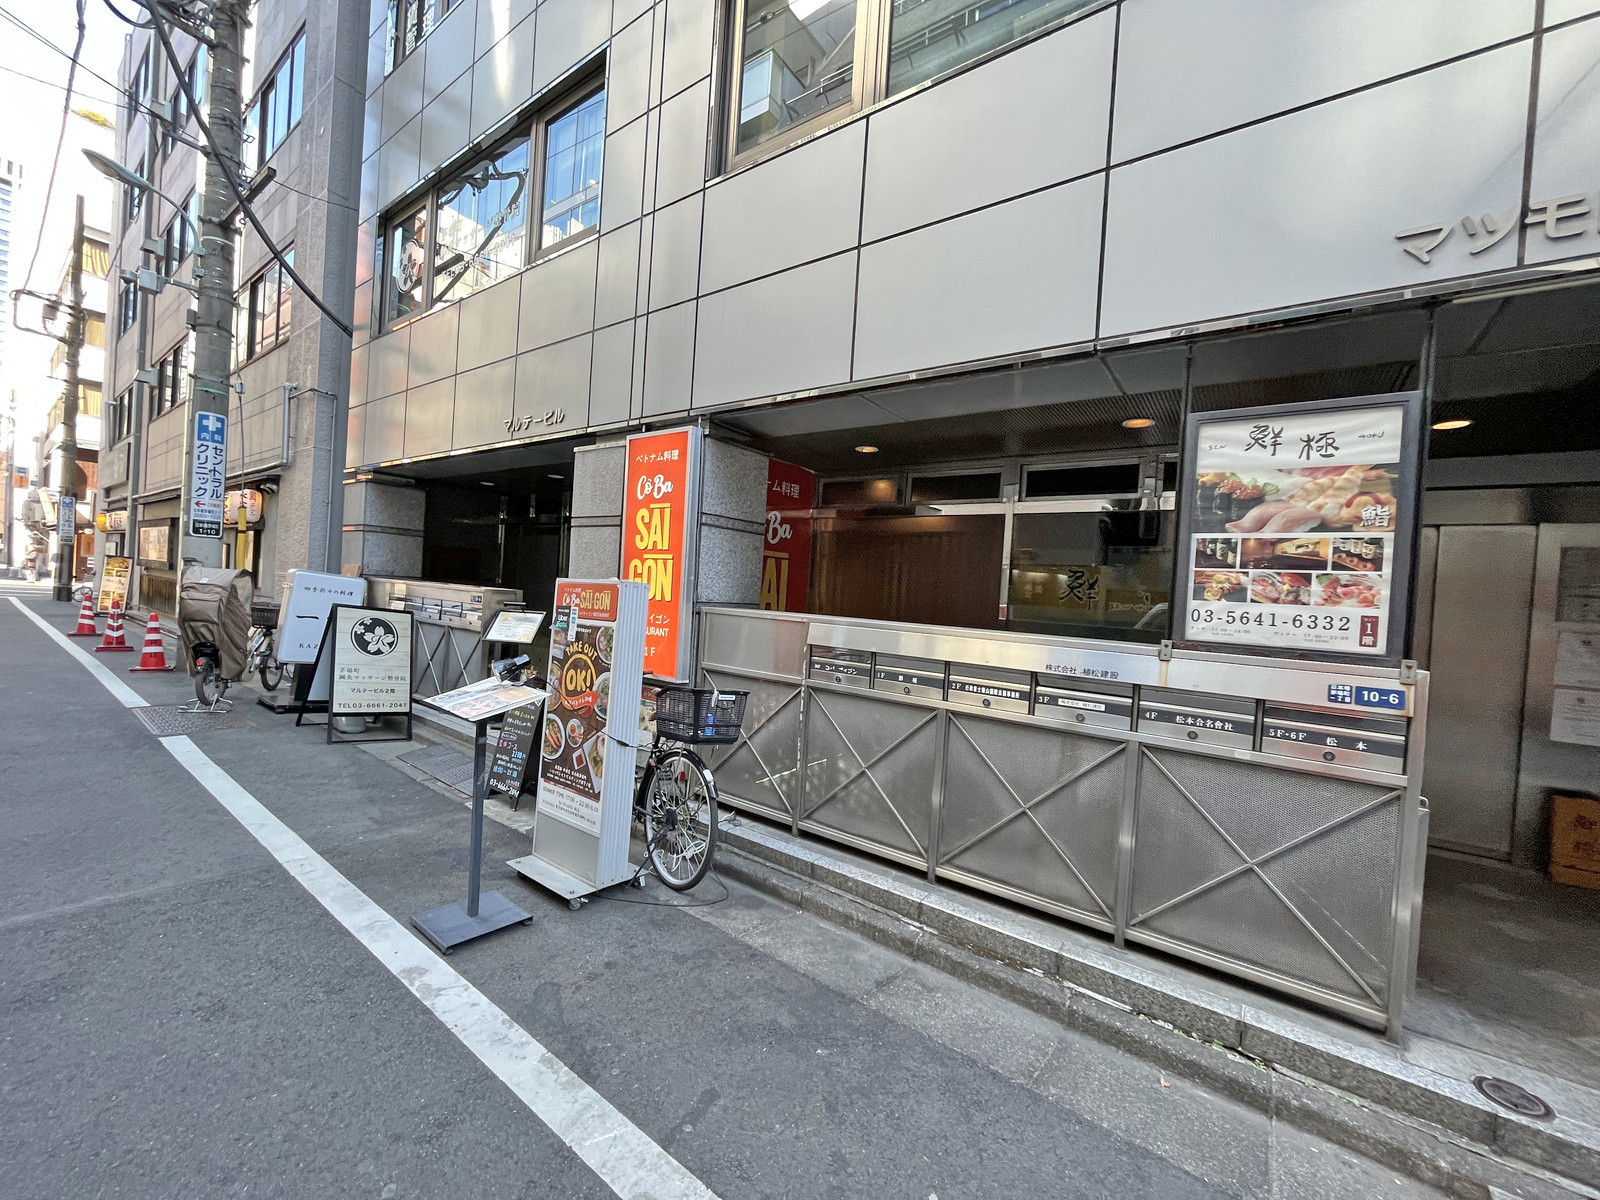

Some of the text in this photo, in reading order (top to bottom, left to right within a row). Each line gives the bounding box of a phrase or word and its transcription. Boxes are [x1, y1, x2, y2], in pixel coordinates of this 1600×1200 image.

[1395, 190, 1600, 264] マツモ
[504, 408, 565, 432] マルテービル
[201, 432, 222, 442] 内科
[636, 450, 679, 462] ベトナム料理
[195, 443, 210, 497] クリニック
[210, 446, 224, 499] セントラル
[653, 474, 674, 499] Ba
[635, 503, 671, 550] SAI
[767, 510, 793, 544] Ba
[1360, 504, 1391, 527] 鮨
[629, 554, 674, 602] GON
[304, 586, 354, 596] 四季折々の料理
[1191, 608, 1350, 632] 03-5641-6332
[566, 641, 598, 660] TAKE OUT
[567, 668, 591, 693] OK!
[1045, 664, 1119, 680] 株式会社 植松建設
[1038, 696, 1049, 704] 3F
[1362, 690, 1399, 704] 10-6
[1176, 715, 1233, 731] 松本合名會社
